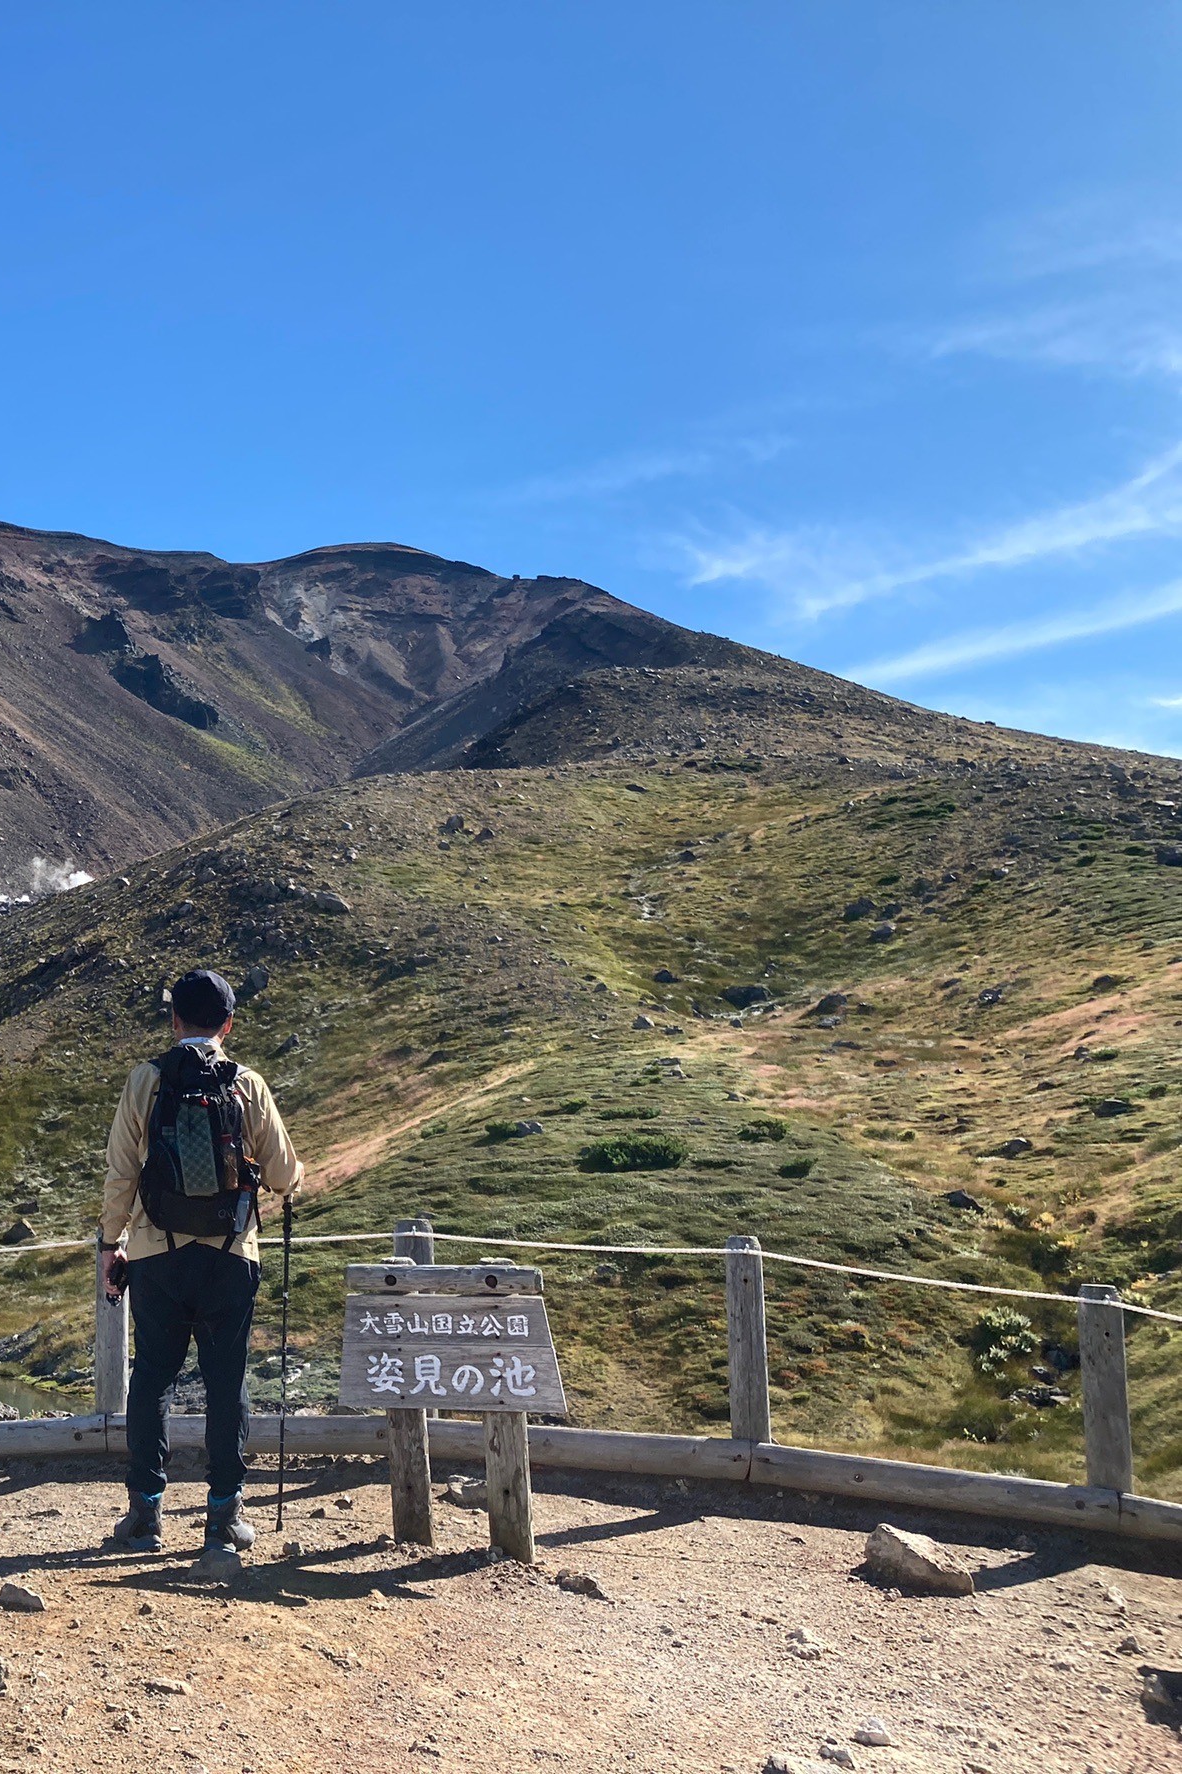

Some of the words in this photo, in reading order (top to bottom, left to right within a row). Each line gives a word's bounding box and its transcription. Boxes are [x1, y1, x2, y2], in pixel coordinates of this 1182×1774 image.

[359, 1311, 529, 1337] 大雪山国立公園
[366, 1352, 536, 1397] 姿見の池
